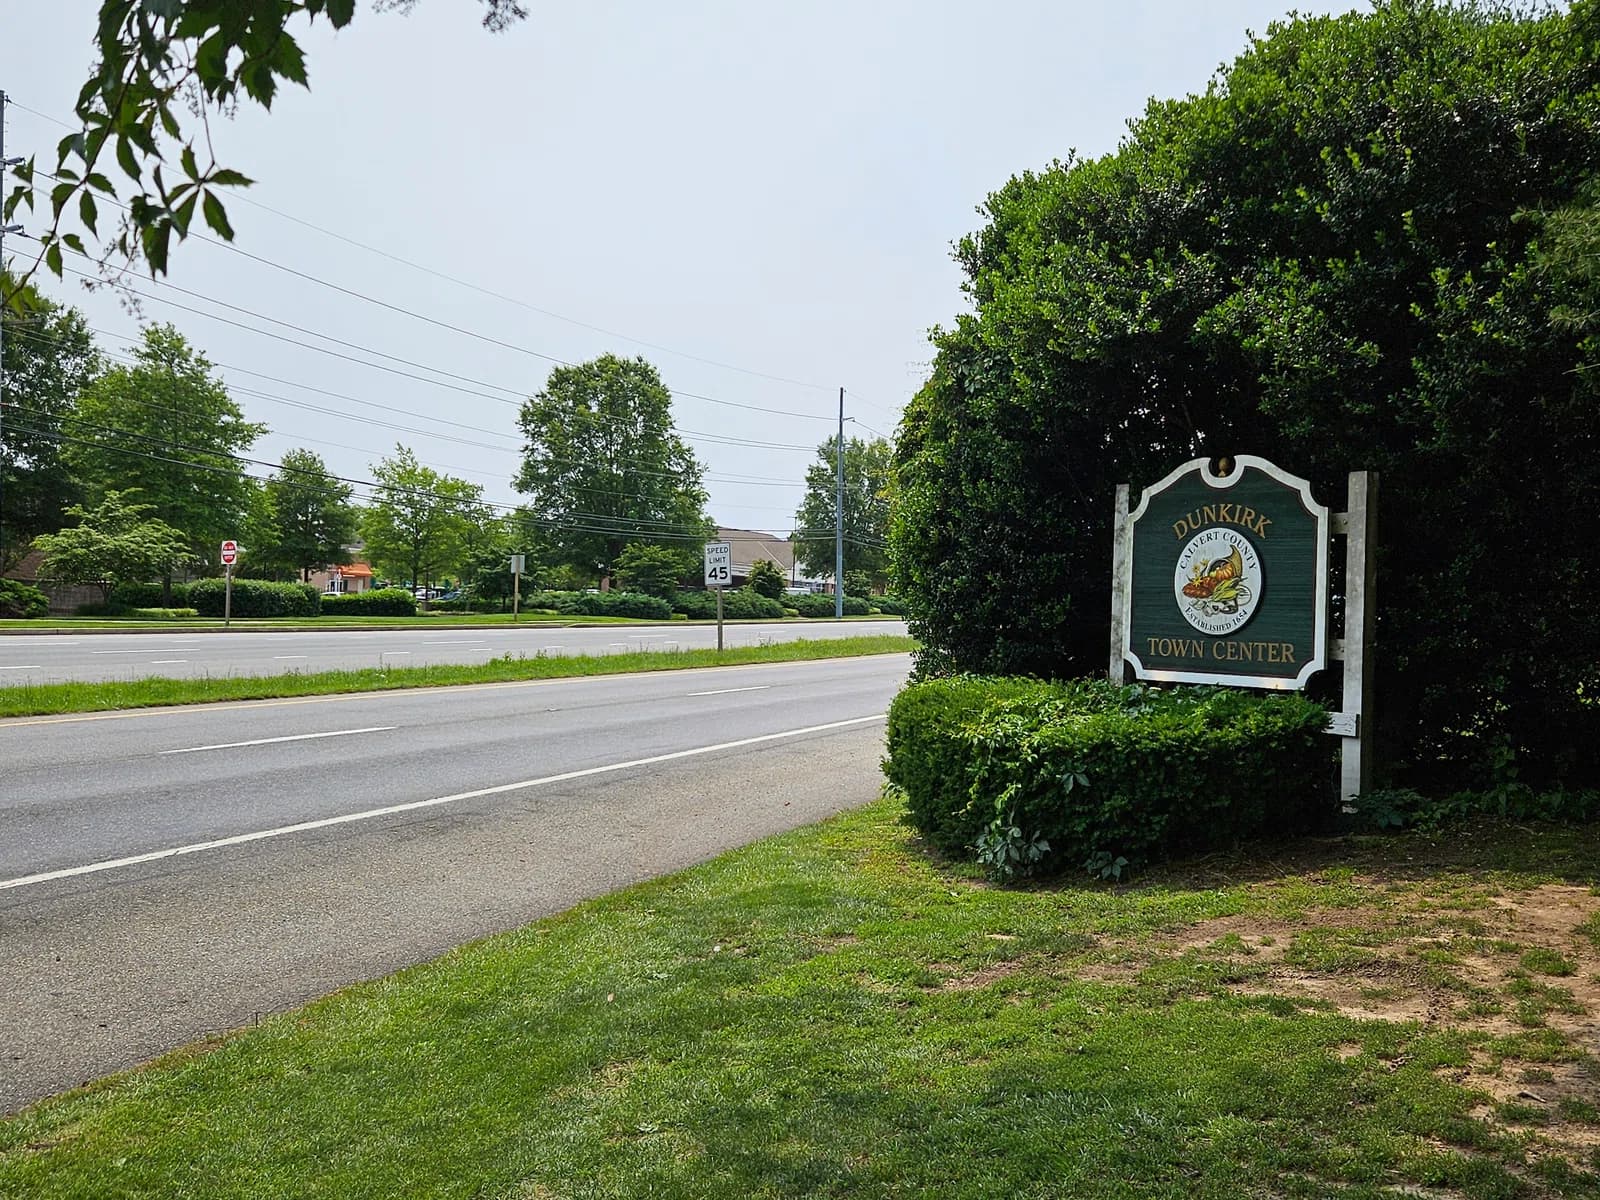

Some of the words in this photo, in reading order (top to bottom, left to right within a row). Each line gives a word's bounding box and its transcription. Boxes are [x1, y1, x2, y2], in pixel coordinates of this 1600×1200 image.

[1172, 503, 1273, 540] DUNKIRK
[1180, 531, 1220, 570] CALVERT
[1222, 532, 1257, 571] COUNTY
[708, 566, 728, 580] 45
[1184, 606, 1232, 632] ESTABLISHED
[1232, 609, 1249, 626] 1654
[1148, 637, 1205, 658] TOWN
[1212, 641, 1296, 664] CENTER
